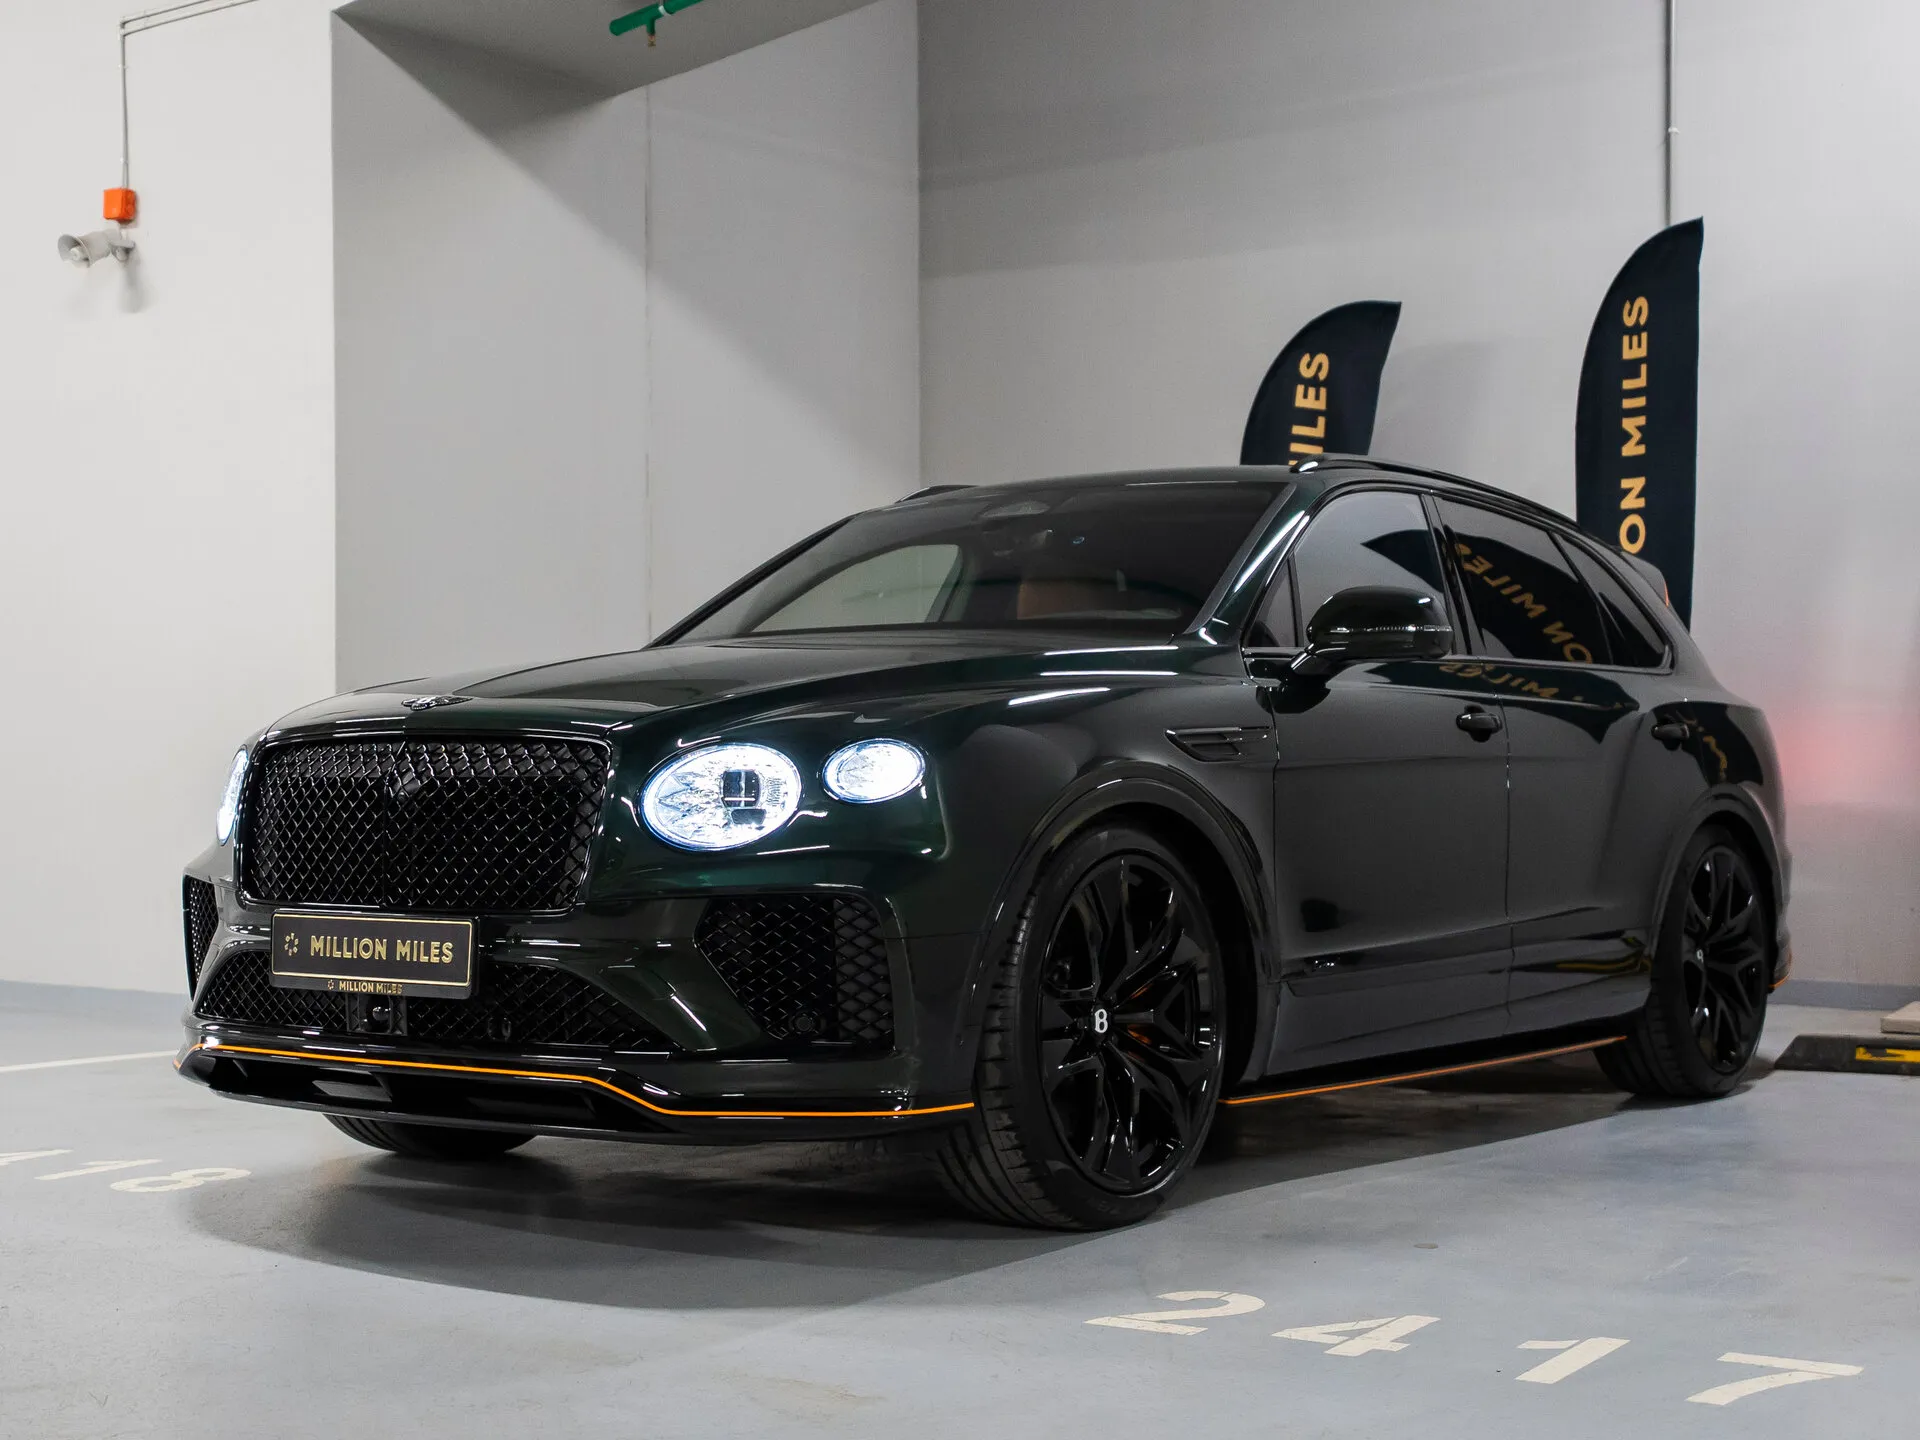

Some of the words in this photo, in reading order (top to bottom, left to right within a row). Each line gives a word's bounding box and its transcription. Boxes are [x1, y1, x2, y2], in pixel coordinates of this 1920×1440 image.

[1288, 352, 1330, 466] ILES
[1621, 295, 1649, 457] MILES
[310, 935, 388, 961] MILLION
[396, 939, 454, 964] MILES
[339, 980, 374, 993] MILLION
[376, 983, 403, 995] MILES
